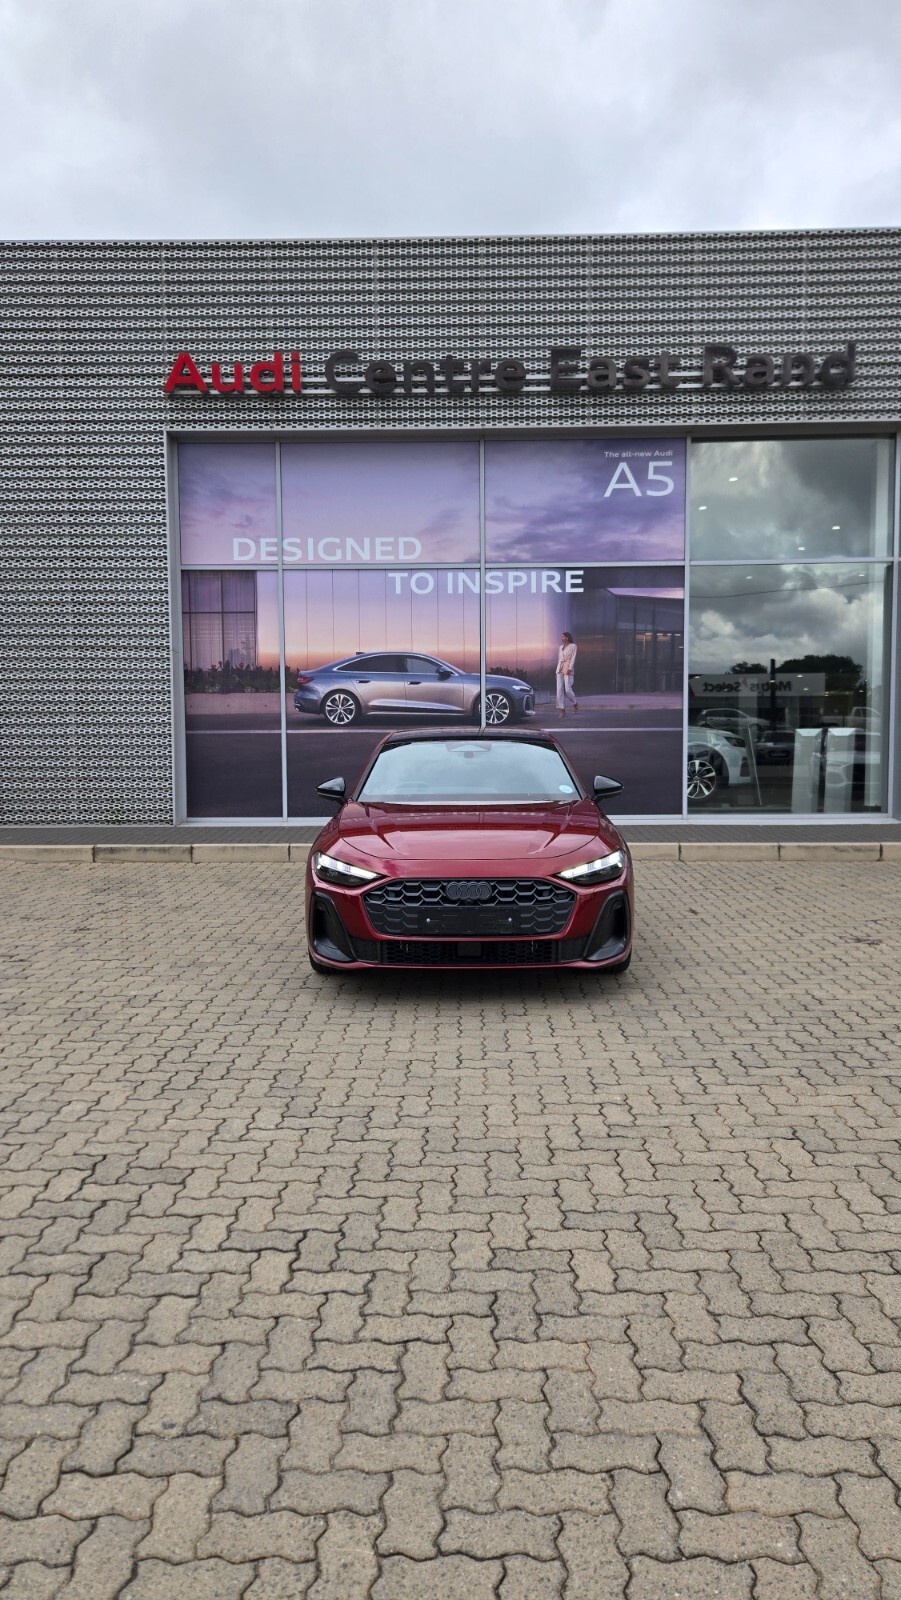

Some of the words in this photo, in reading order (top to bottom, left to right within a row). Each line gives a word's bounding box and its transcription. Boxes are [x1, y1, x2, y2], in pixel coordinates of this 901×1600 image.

[162, 351, 301, 393] Audi
[324, 350, 527, 394] Centre
[550, 348, 682, 391] East
[703, 341, 857, 388] Rand
[603, 461, 675, 498] A5
[232, 537, 422, 561] DESIGNED
[388, 572, 435, 595] TO
[447, 570, 585, 594] INSPIRE
